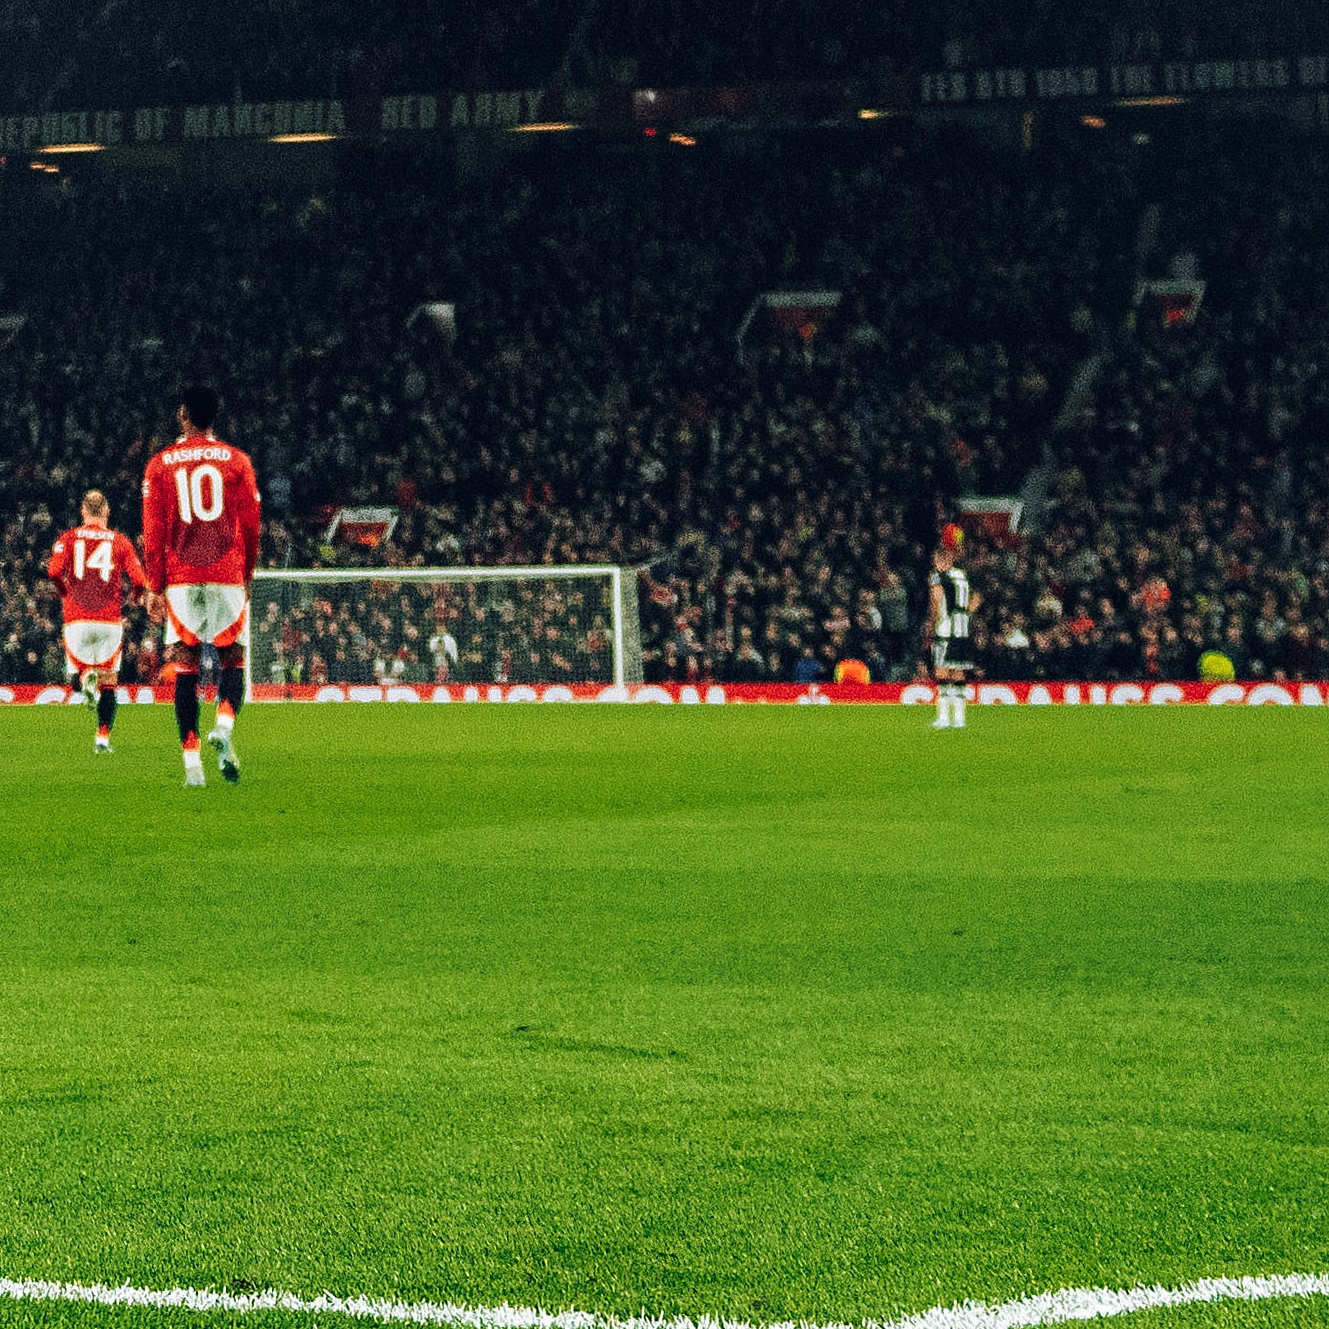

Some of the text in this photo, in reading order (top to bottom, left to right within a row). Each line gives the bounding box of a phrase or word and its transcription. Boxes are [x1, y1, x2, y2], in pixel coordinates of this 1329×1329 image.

[135, 106, 170, 141] OF
[381, 89, 546, 130] RED ARMY
[164, 447, 231, 465] RASHFORD
[175, 464, 223, 524] 10
[74, 539, 115, 583] 14
